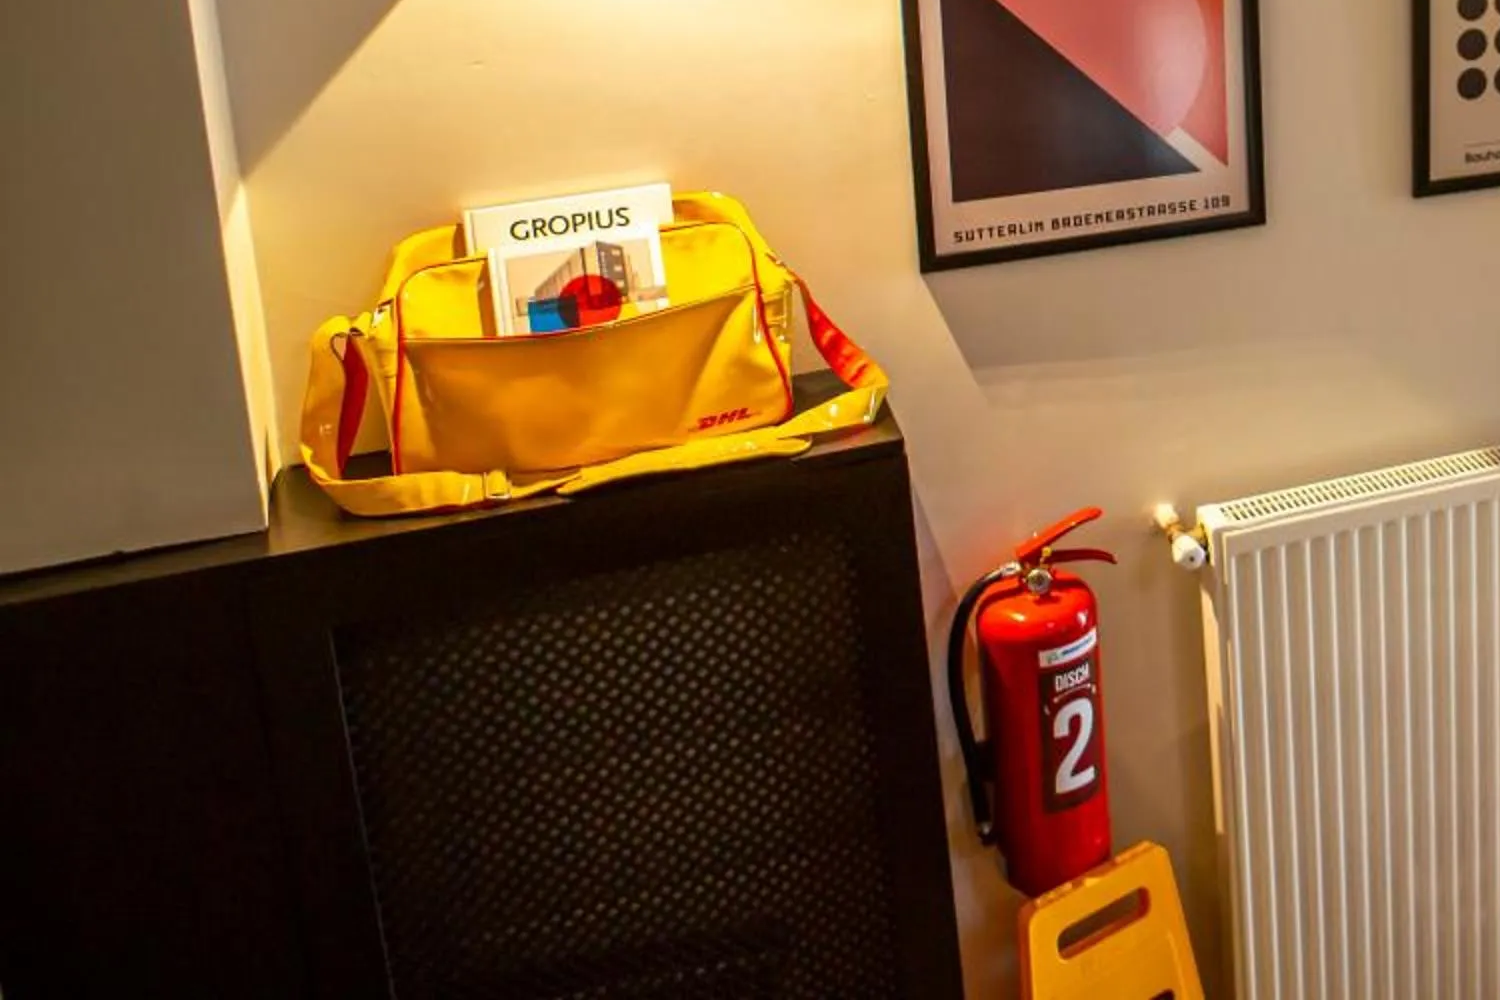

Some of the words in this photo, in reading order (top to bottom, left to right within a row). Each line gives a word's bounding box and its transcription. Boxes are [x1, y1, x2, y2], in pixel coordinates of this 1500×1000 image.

[509, 206, 631, 241] GROPIUS
[699, 407, 751, 430] DHL
[1052, 697, 1096, 794] 2
